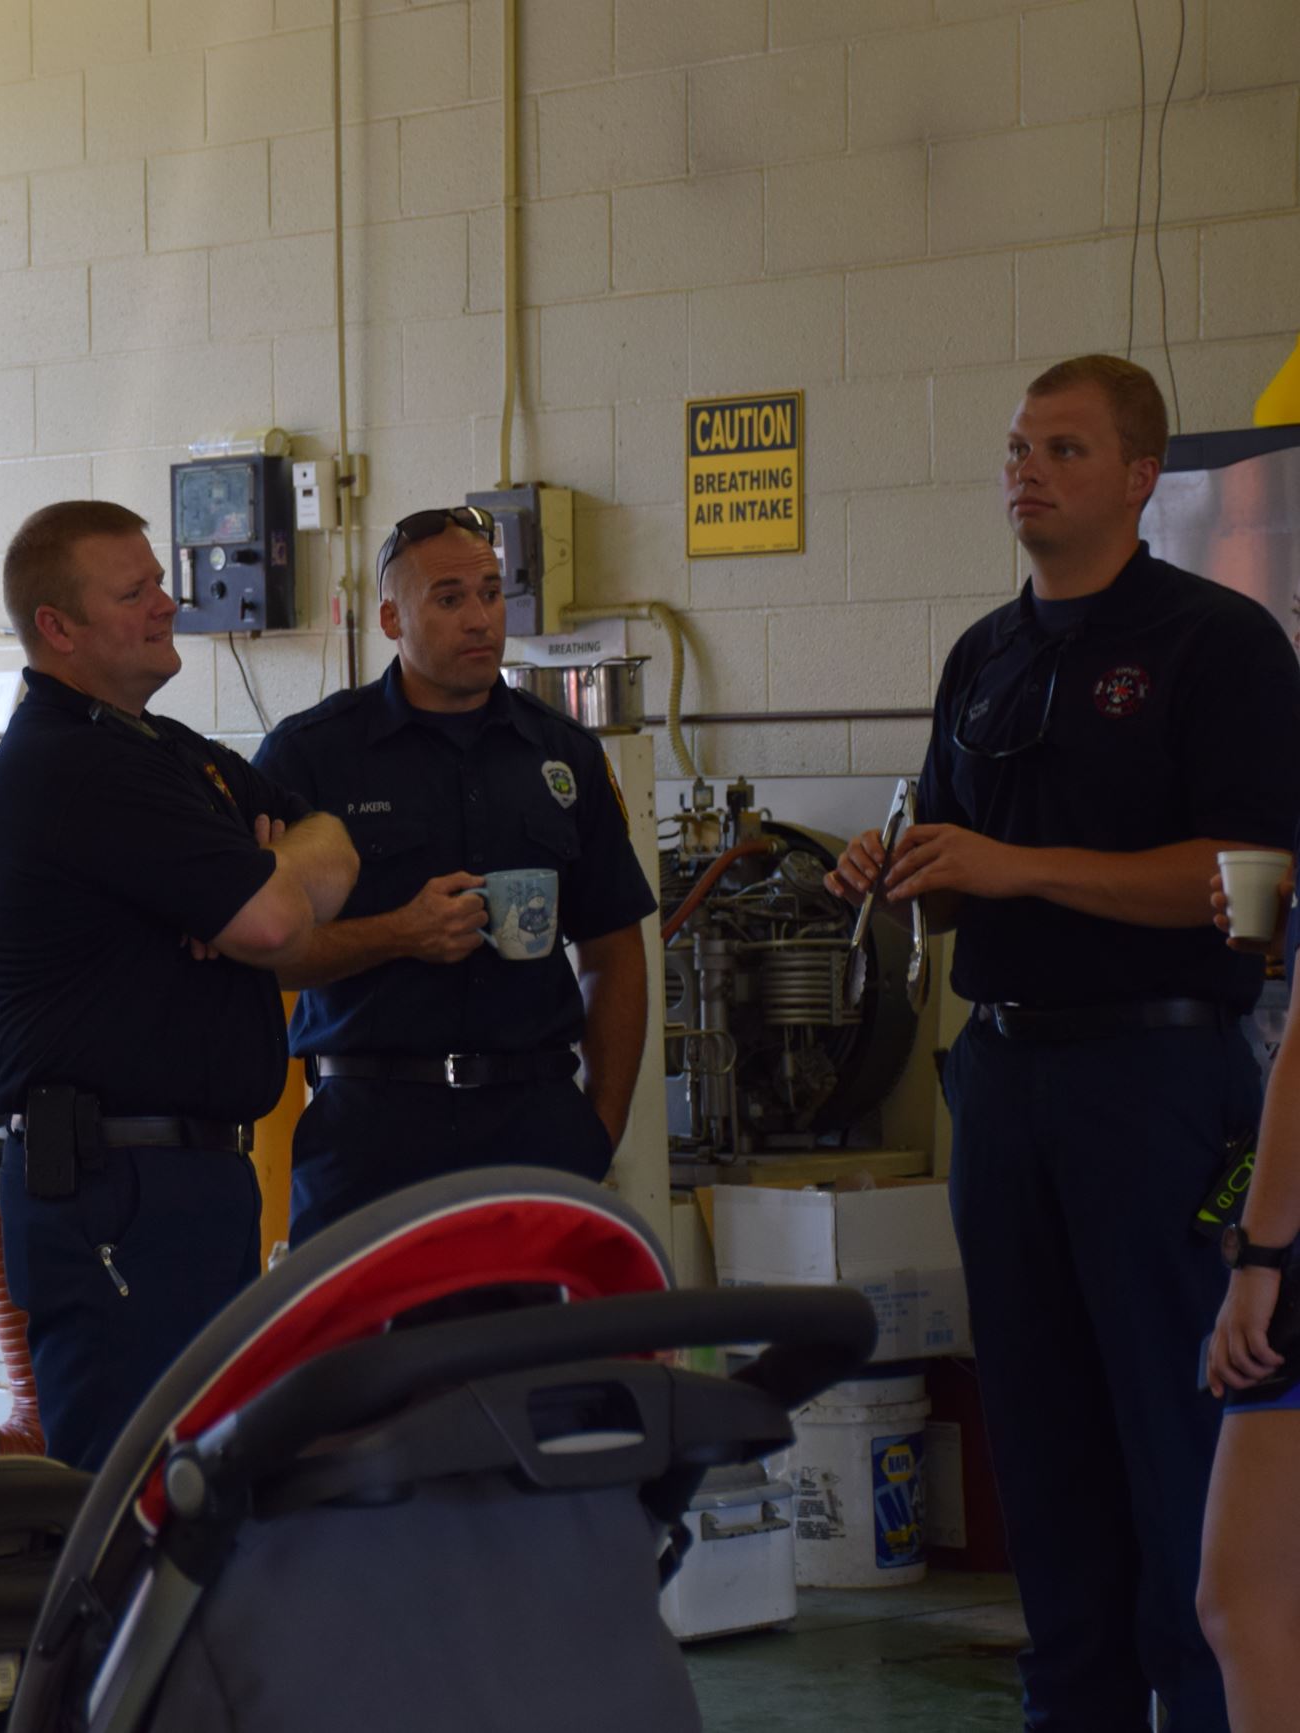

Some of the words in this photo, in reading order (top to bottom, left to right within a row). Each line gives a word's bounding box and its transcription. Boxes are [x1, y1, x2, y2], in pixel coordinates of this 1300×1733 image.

[695, 403, 792, 453] CAUTION
[694, 467, 792, 495] BREATHING
[695, 502, 723, 525] AIR
[729, 498, 793, 523] INTAKE
[548, 641, 601, 656] BREATHING
[359, 801, 391, 815] AKERS
